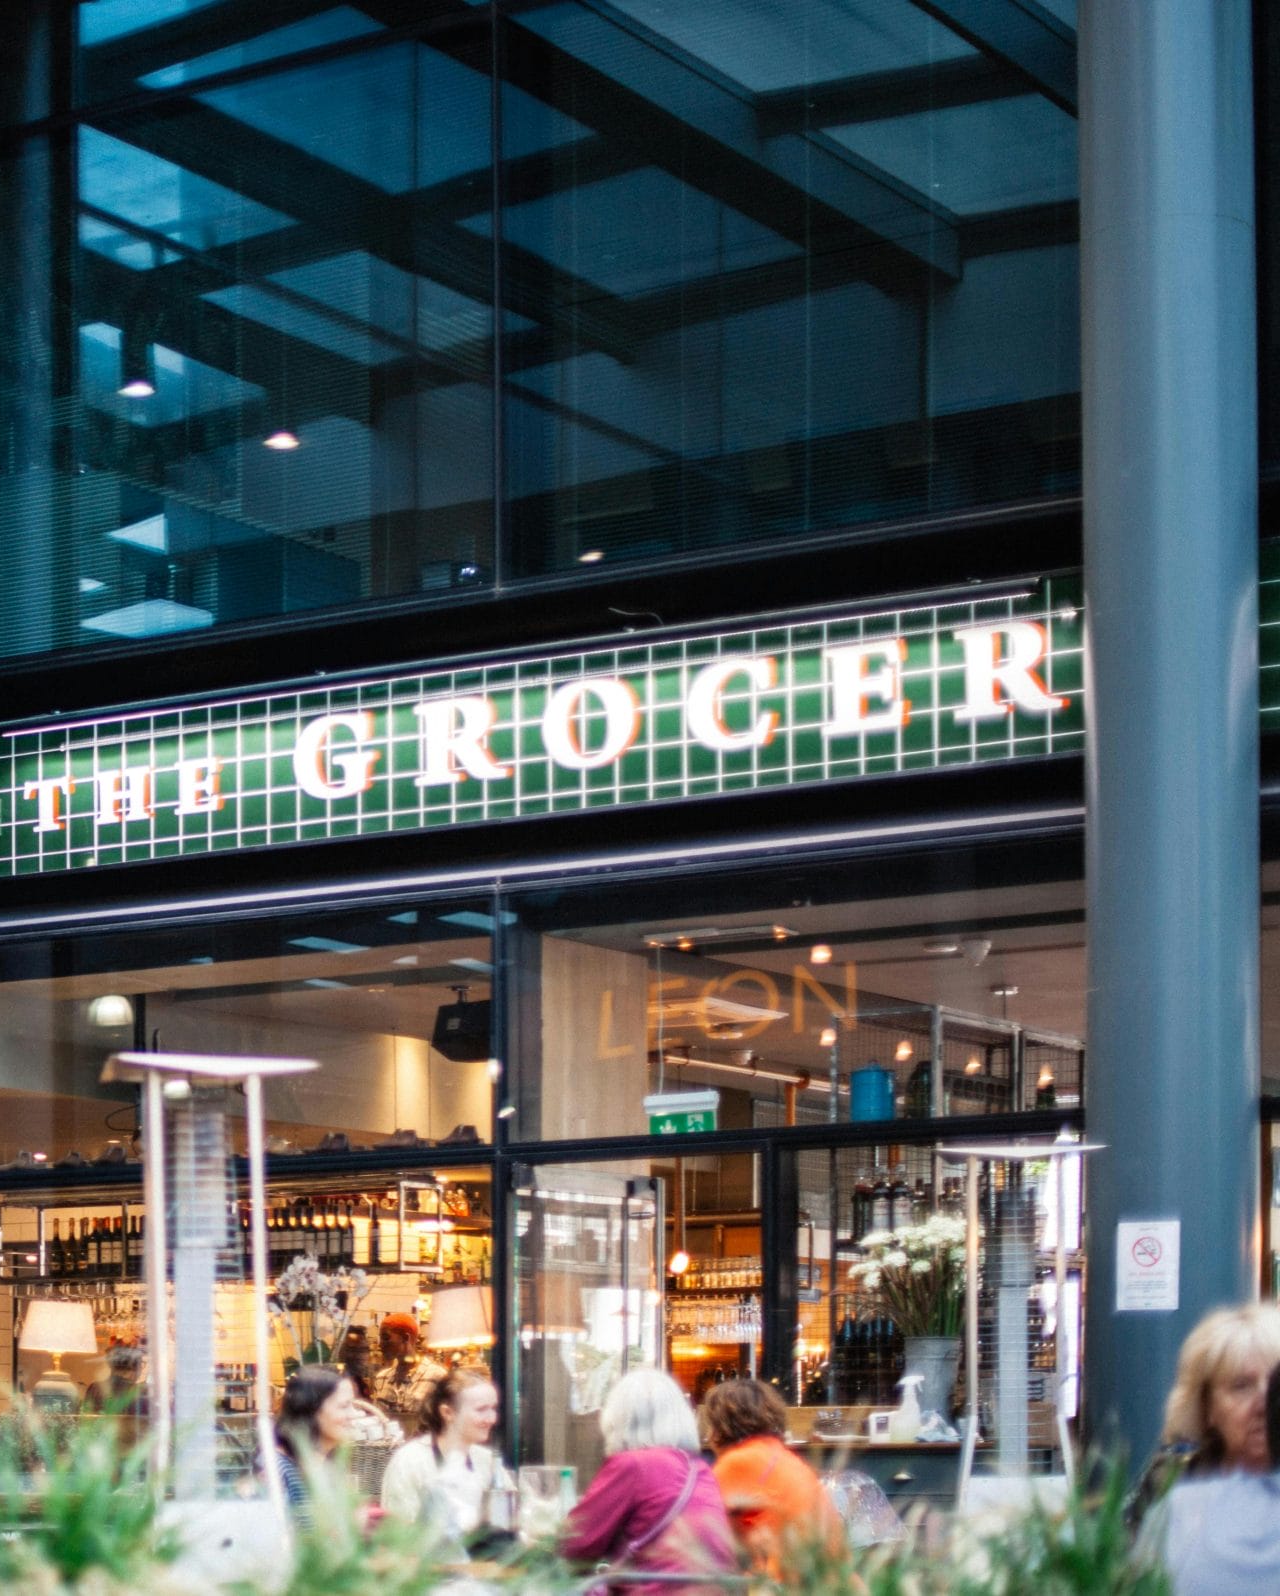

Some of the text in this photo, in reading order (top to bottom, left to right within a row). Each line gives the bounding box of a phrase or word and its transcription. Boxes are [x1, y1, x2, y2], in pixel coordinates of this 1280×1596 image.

[23, 621, 1071, 832] THE GROCER
[598, 960, 858, 1060] LEON
